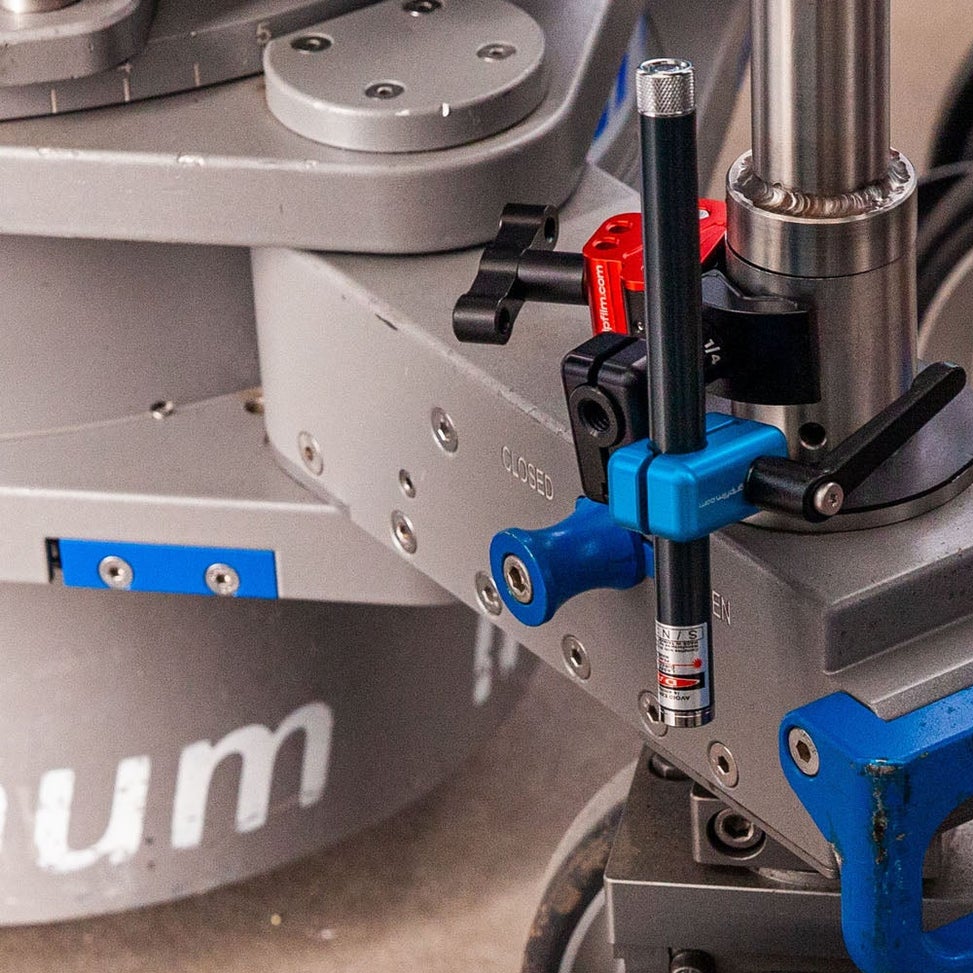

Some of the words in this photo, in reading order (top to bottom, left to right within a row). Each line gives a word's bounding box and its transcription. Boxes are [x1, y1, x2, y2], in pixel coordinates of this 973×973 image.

[502, 446, 554, 500] CLOSED
[711, 590, 731, 625] EN
[0, 702, 333, 875] um
